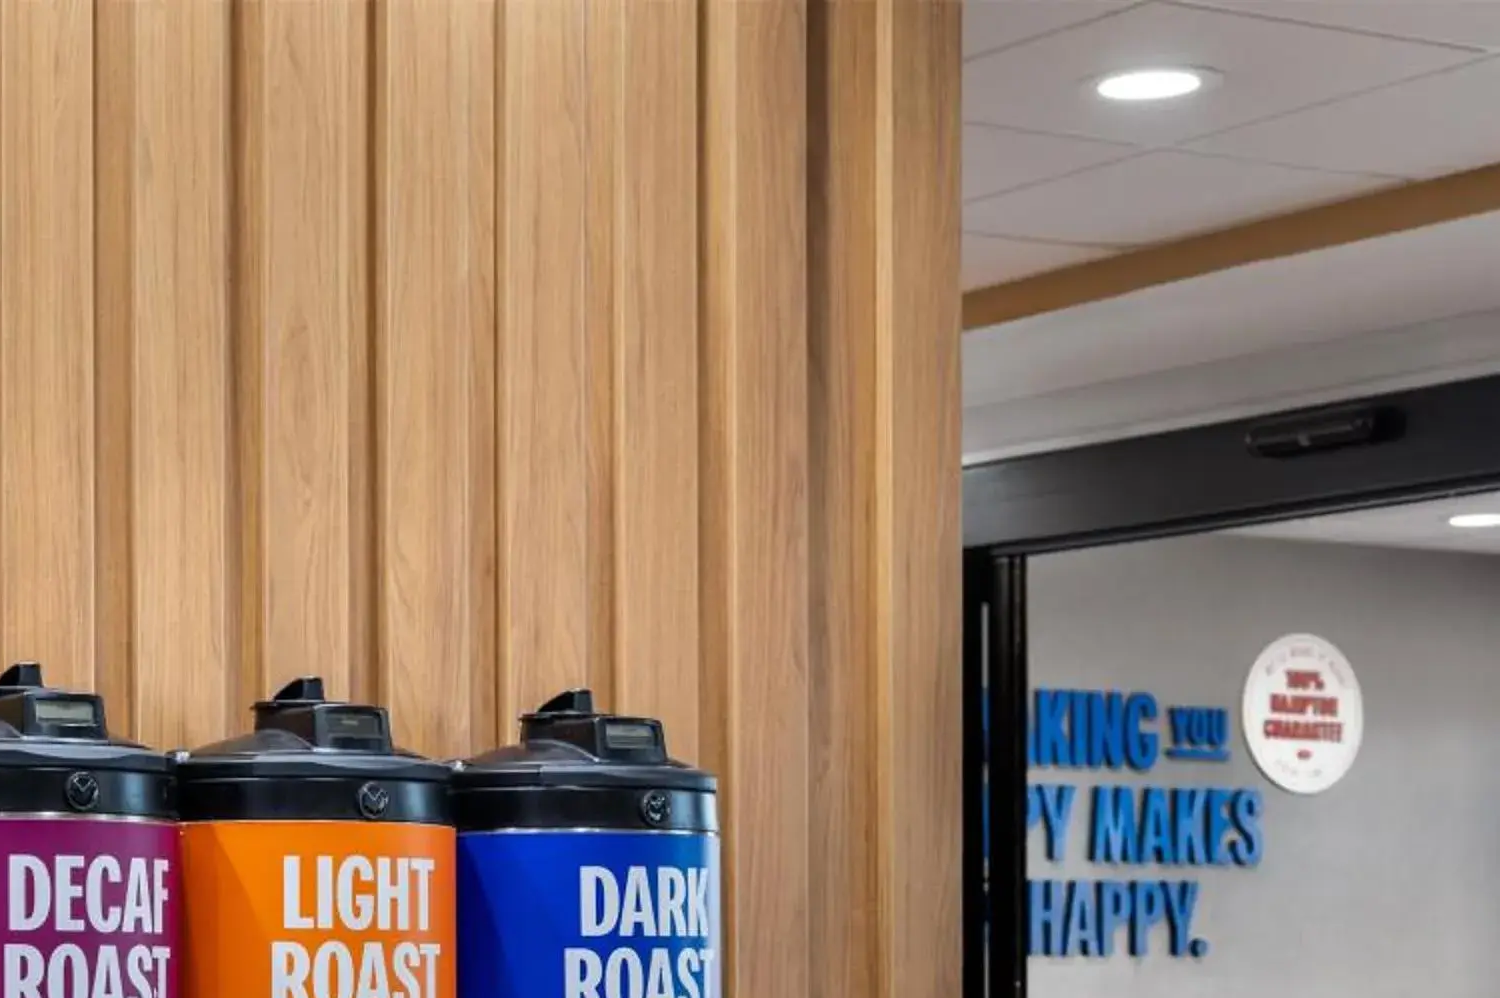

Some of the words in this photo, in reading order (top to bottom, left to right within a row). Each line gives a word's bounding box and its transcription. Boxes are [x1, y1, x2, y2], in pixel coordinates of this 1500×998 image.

[1027, 688, 1158, 771] KING
[1167, 705, 1228, 748] YOU
[1089, 784, 1264, 867] MAKES
[7, 854, 169, 935] DECAF
[282, 855, 435, 932] LIGHT
[578, 866, 710, 938] DARK
[1027, 879, 1210, 959] HAPPY.
